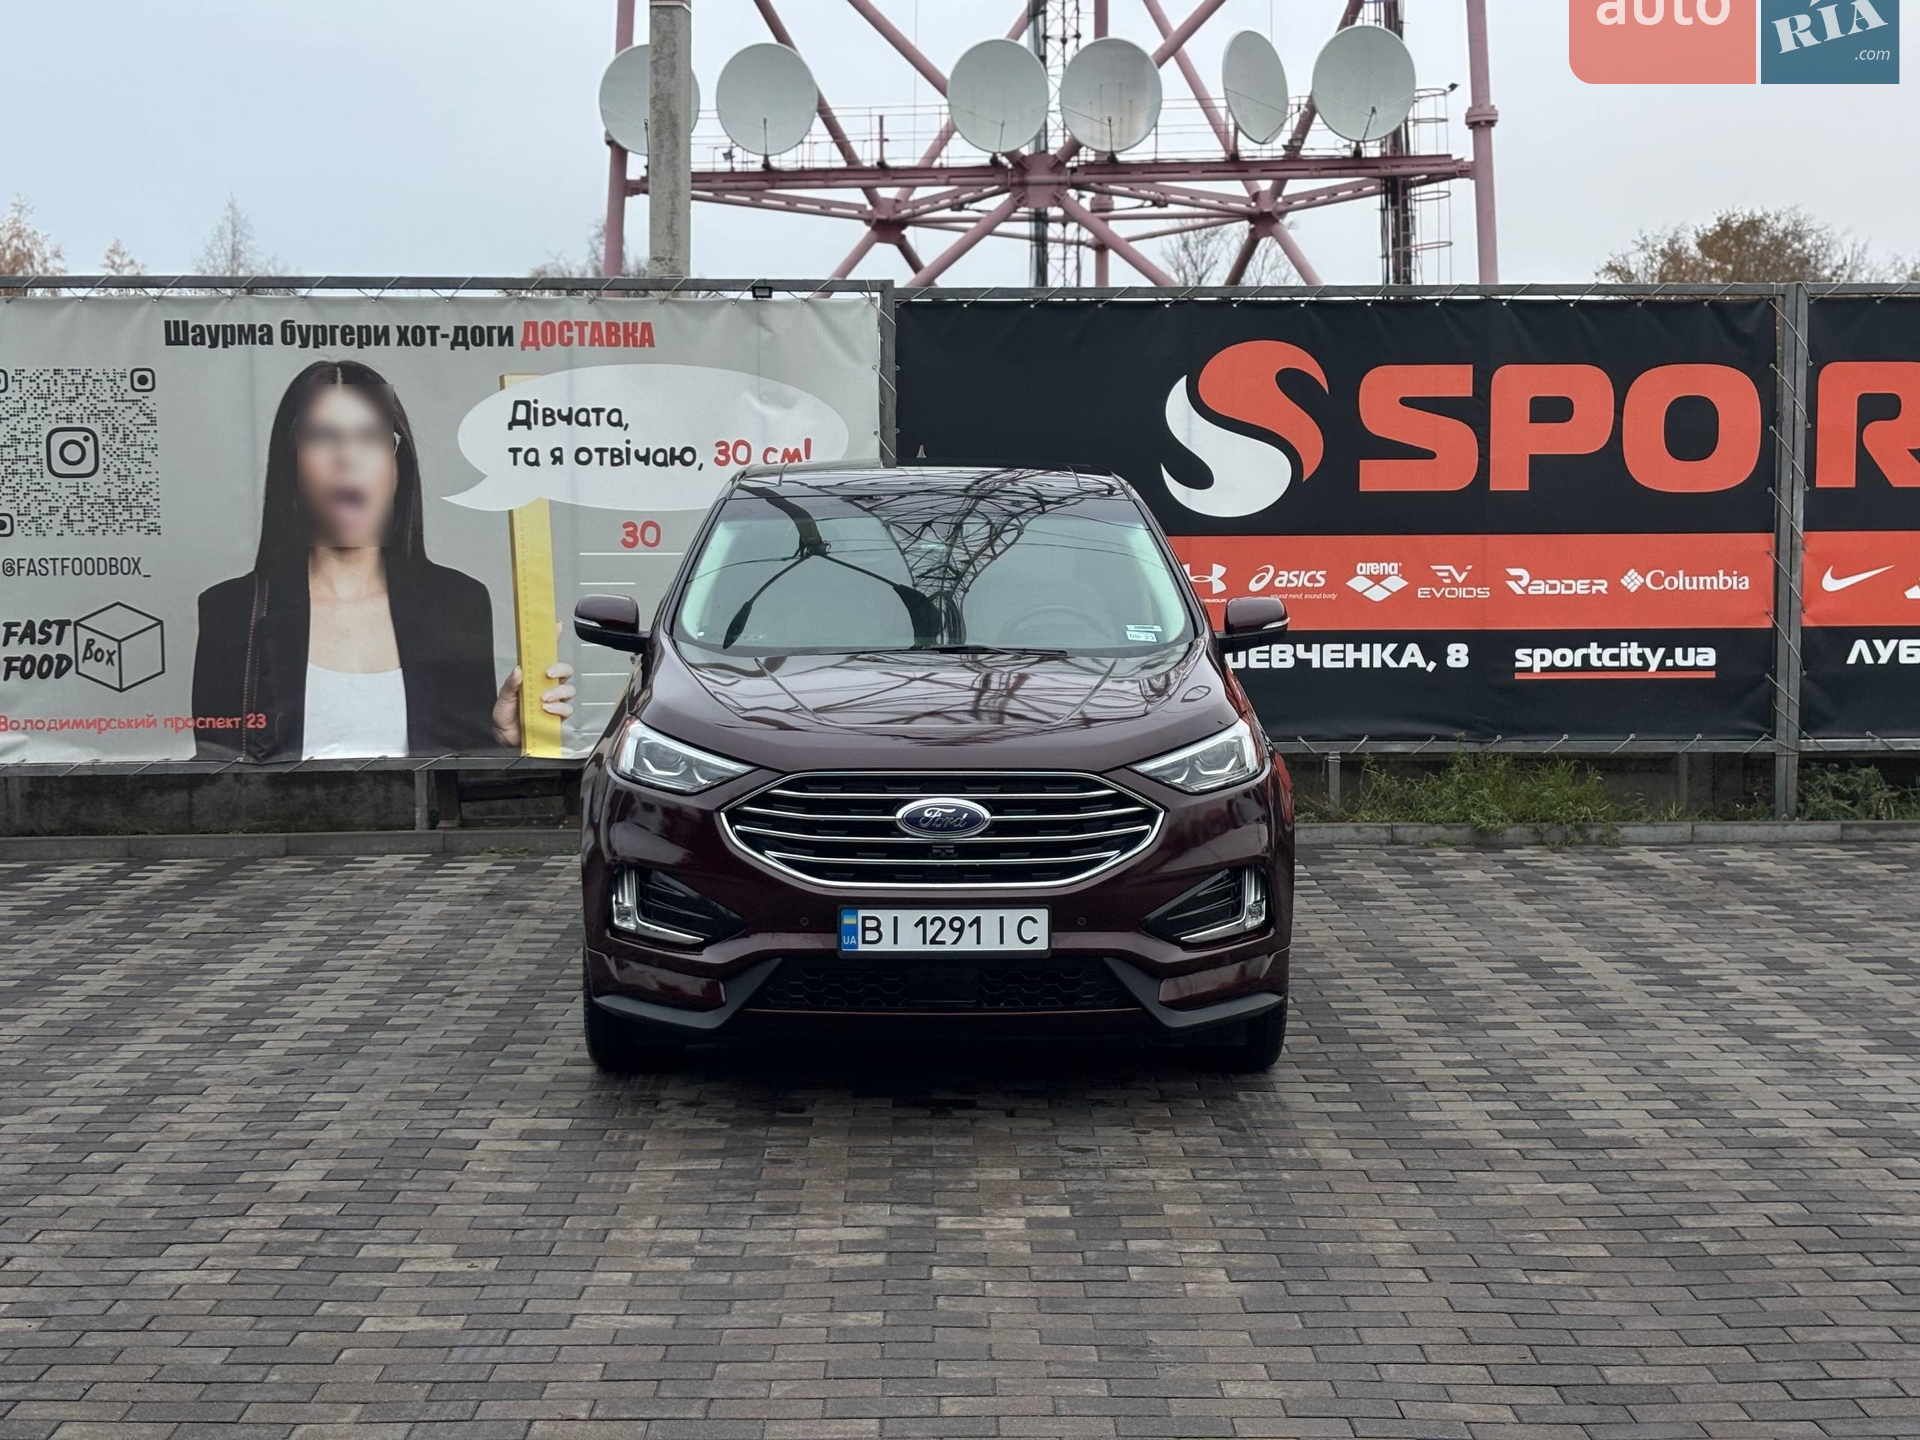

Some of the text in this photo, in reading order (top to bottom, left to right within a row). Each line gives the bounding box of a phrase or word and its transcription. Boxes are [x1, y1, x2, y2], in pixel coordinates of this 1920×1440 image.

[164, 319, 656, 351] Шаурма бургери хот-доги ДОСТАВКА
[508, 399, 630, 431] Дівчата,
[508, 437, 813, 472] та я отвічаю, 30 см!
[621, 521, 661, 549] 30
[2, 556, 152, 578] @FASTFOODBOX_
[1274, 570, 1327, 588] asics
[1356, 562, 1399, 576] arena
[1417, 586, 1491, 599] EVOIDS
[1645, 569, 1750, 591] Columbia
[2, 619, 72, 647] FAST
[3, 654, 73, 682] FOOD
[1446, 643, 1469, 668] 8
[1514, 642, 1716, 672] sportcity.ua
[0, 713, 267, 735] Володимирський проспект 23
[919, 807, 968, 829] Ford
[843, 935, 857, 945] UA
[913, 915, 982, 945] 1291
